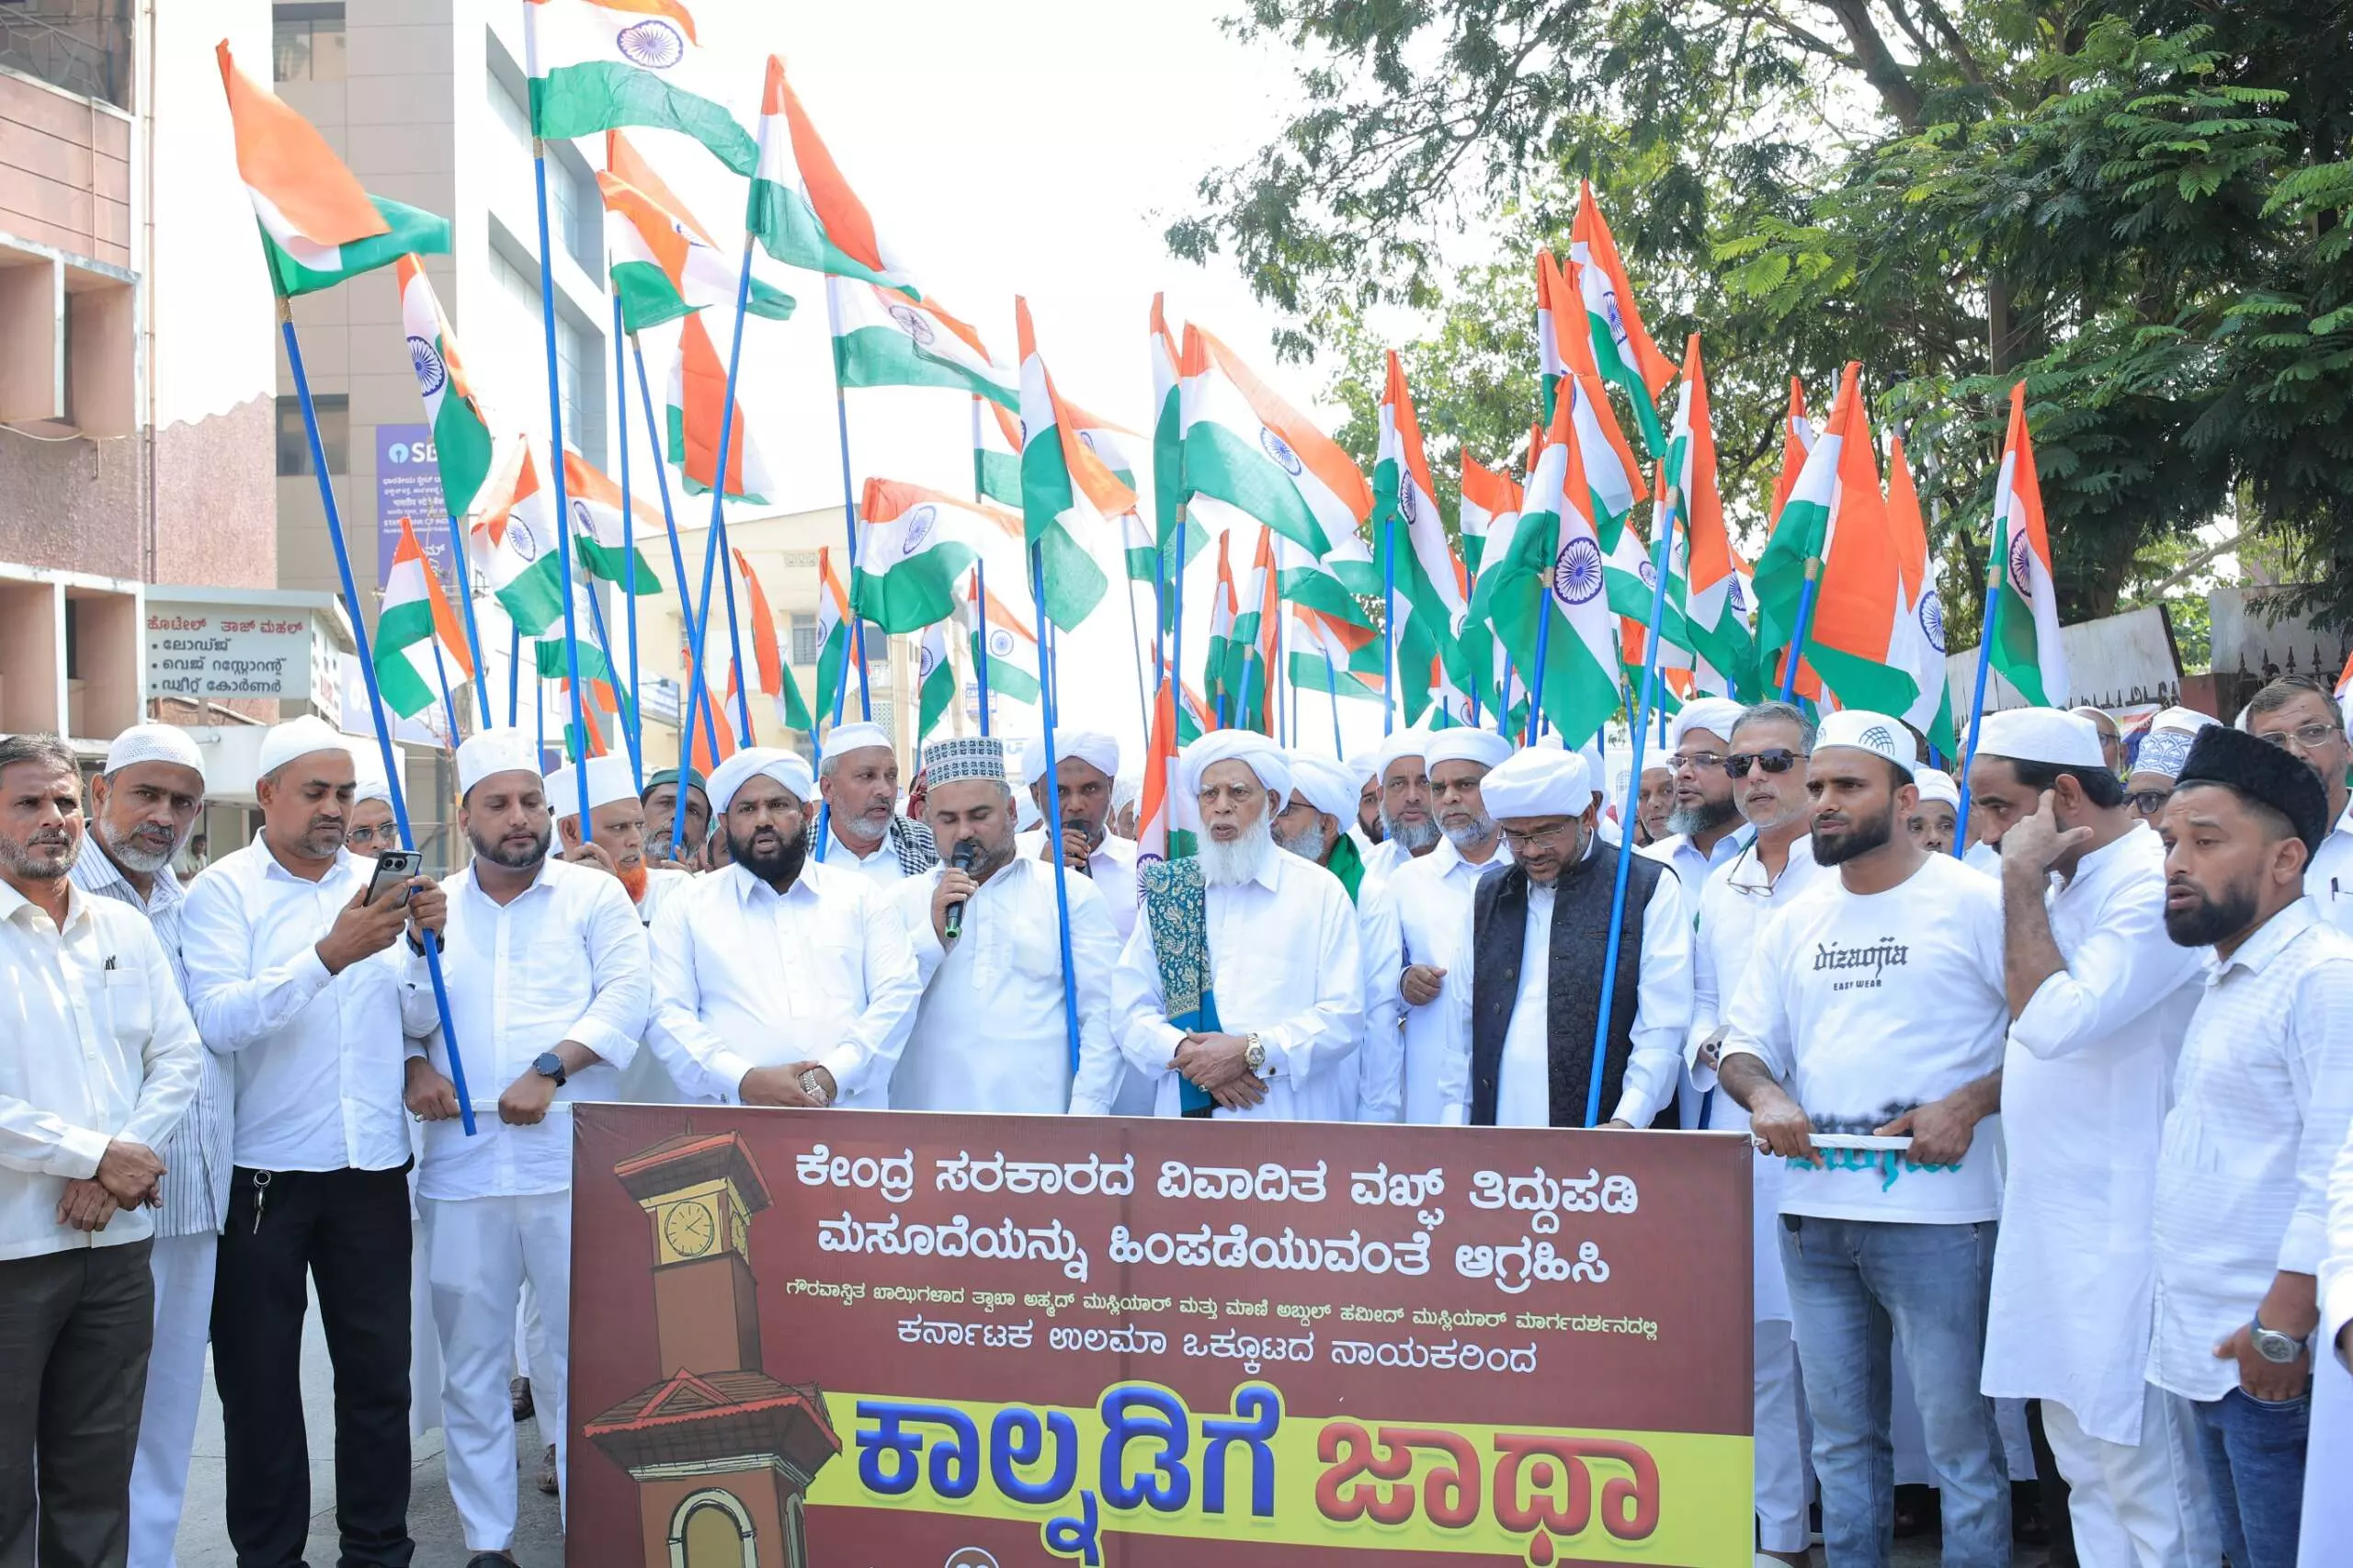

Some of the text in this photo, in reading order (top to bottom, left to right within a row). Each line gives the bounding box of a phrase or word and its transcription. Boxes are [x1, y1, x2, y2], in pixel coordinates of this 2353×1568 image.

[163, 638, 232, 652] ലോഡ്ജ്
[221, 619, 256, 634] ತಾಜ್
[260, 619, 304, 635] ಮಹಲ್
[163, 656, 206, 671] വെജ്
[1856, 979, 1882, 988] WEAR
[796, 1144, 1639, 1234] ಕೇಂದ್ರ ಸರಕಾರದ ವಿವಾದಿತ ವಖ್ಫ್ ತಿದ್ದುಪಡಿ
[818, 1210, 1610, 1294] ಮಸೂದೆಯನ್ನು ಹಿಂಪಡೆಯುವಂತೆ ಆಗ್ರಹಿಸಿ
[786, 1278, 1658, 1341] ಗೌರವಾನ್ವಿತ ಖಾಝಿಗಳಾದ ತ್ವಾಖಾ ಅಹ್ಮದ್ ಮುಸ್ಲಿಯಾರ್ ಮತ್ತು ಮಾಣಿ ಅಬ್ದುಲ್ ಹಮೀದ್ ಮುಸ್ಲಿಯಾರ್ ಮಾರ್ಗದರ್ಶನದಲ್ಲಿ
[897, 1313, 1537, 1375] ಕರ್ನಾಟಕ ಉಲಮಾ ಒಕ್ಕೂಟದ ನಾಯಕರಿಂದ
[855, 1386, 1661, 1566] ಕಾಲ್ನಡಿಗೆ ಜಾಥಾ
